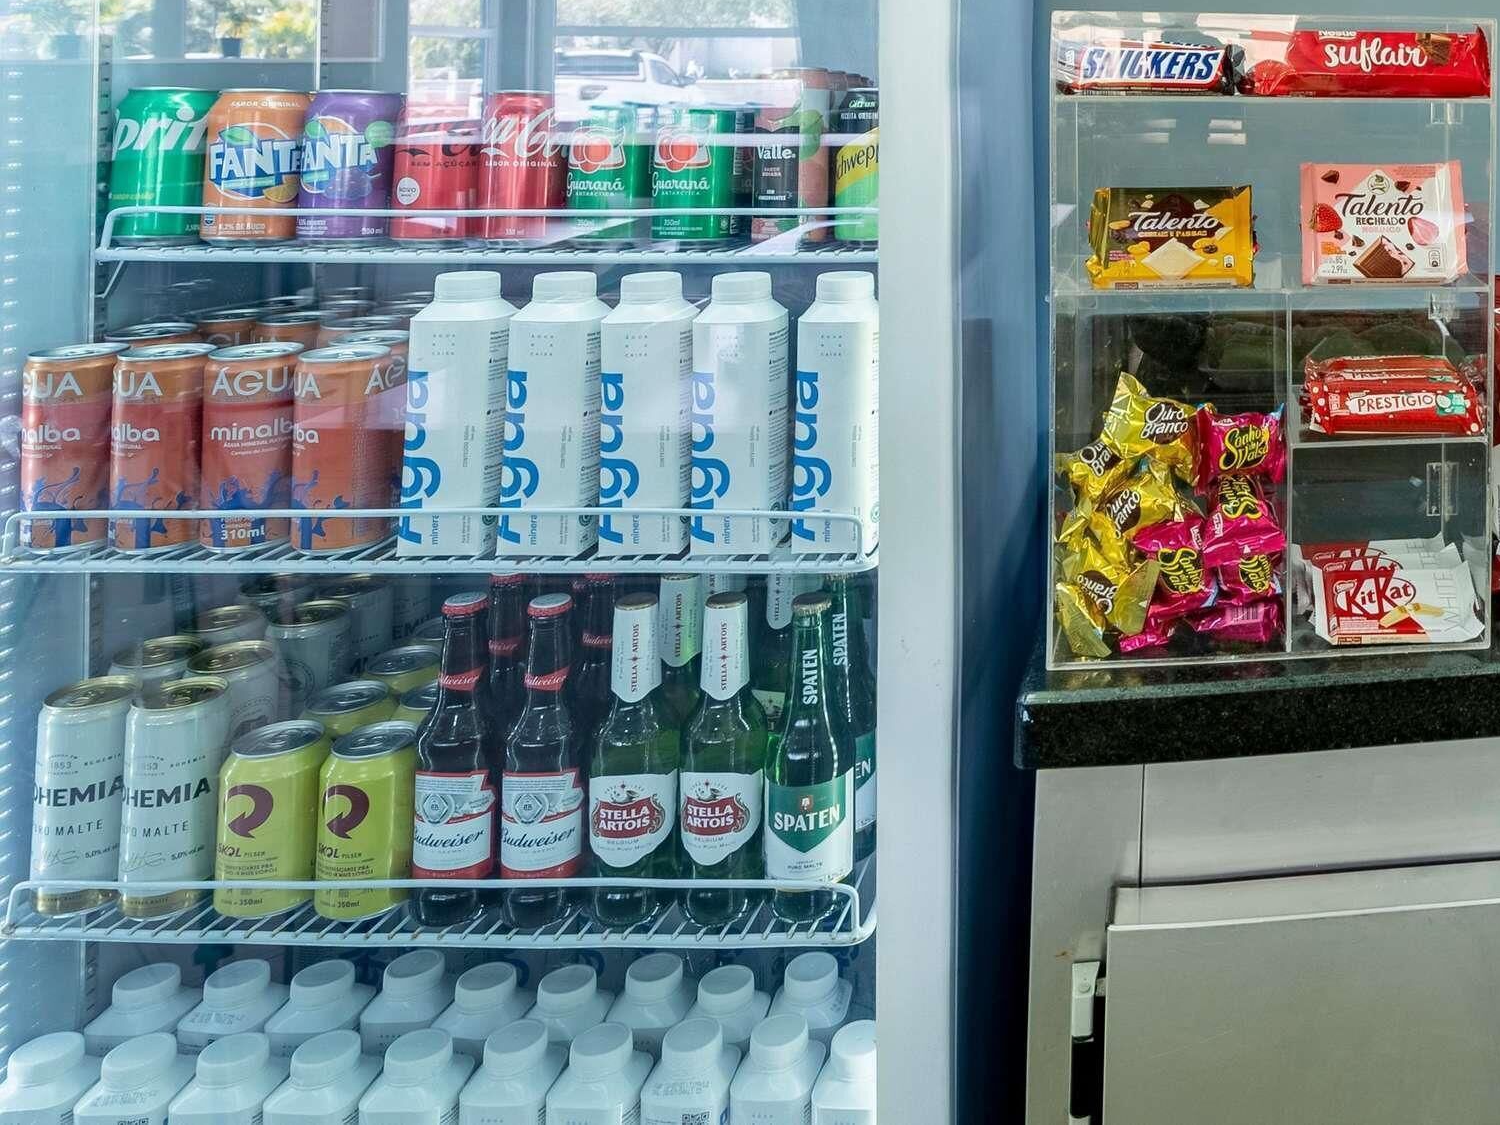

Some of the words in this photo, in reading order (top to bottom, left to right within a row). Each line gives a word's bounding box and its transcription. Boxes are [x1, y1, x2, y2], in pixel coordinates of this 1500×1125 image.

[1083, 49, 1220, 80] SNICKERS
[1324, 37, 1428, 72] suflair
[512, 160, 558, 168] ORIGINAL
[566, 172, 625, 198] Guaraná
[651, 171, 710, 197] Guaraná
[1334, 193, 1424, 217] Talento
[1128, 211, 1220, 232] Talento
[1355, 216, 1406, 226] RECHEADO
[1145, 403, 1186, 423] Ouro
[1357, 394, 1434, 413] PRESTIGIO
[1140, 418, 1189, 439] Branco
[1219, 425, 1262, 471] Sonho
[1237, 442, 1269, 470] Valsa
[220, 524, 266, 541] 310ml
[1345, 571, 1412, 616] KitKat
[1432, 572, 1458, 633] WHITE
[632, 623, 640, 652] ARTOIS
[720, 622, 728, 651] ARTOIS
[832, 612, 848, 666] SPATEN
[630, 664, 639, 693] STELLA
[720, 663, 728, 691] STELLA
[802, 648, 818, 705] SPATEN
[599, 805, 650, 820] STELLA
[686, 804, 734, 819] STELLA
[686, 814, 735, 828] ARTOIS
[773, 803, 841, 833] SPATEN
[55, 819, 104, 837] MALTE
[142, 820, 189, 838] MALTE
[598, 816, 651, 832] ARTOIS
[500, 826, 576, 849] Budweiser
[694, 836, 724, 844] BELGIUM
[217, 842, 242, 858] SKOL
[318, 842, 339, 859] SKOL
